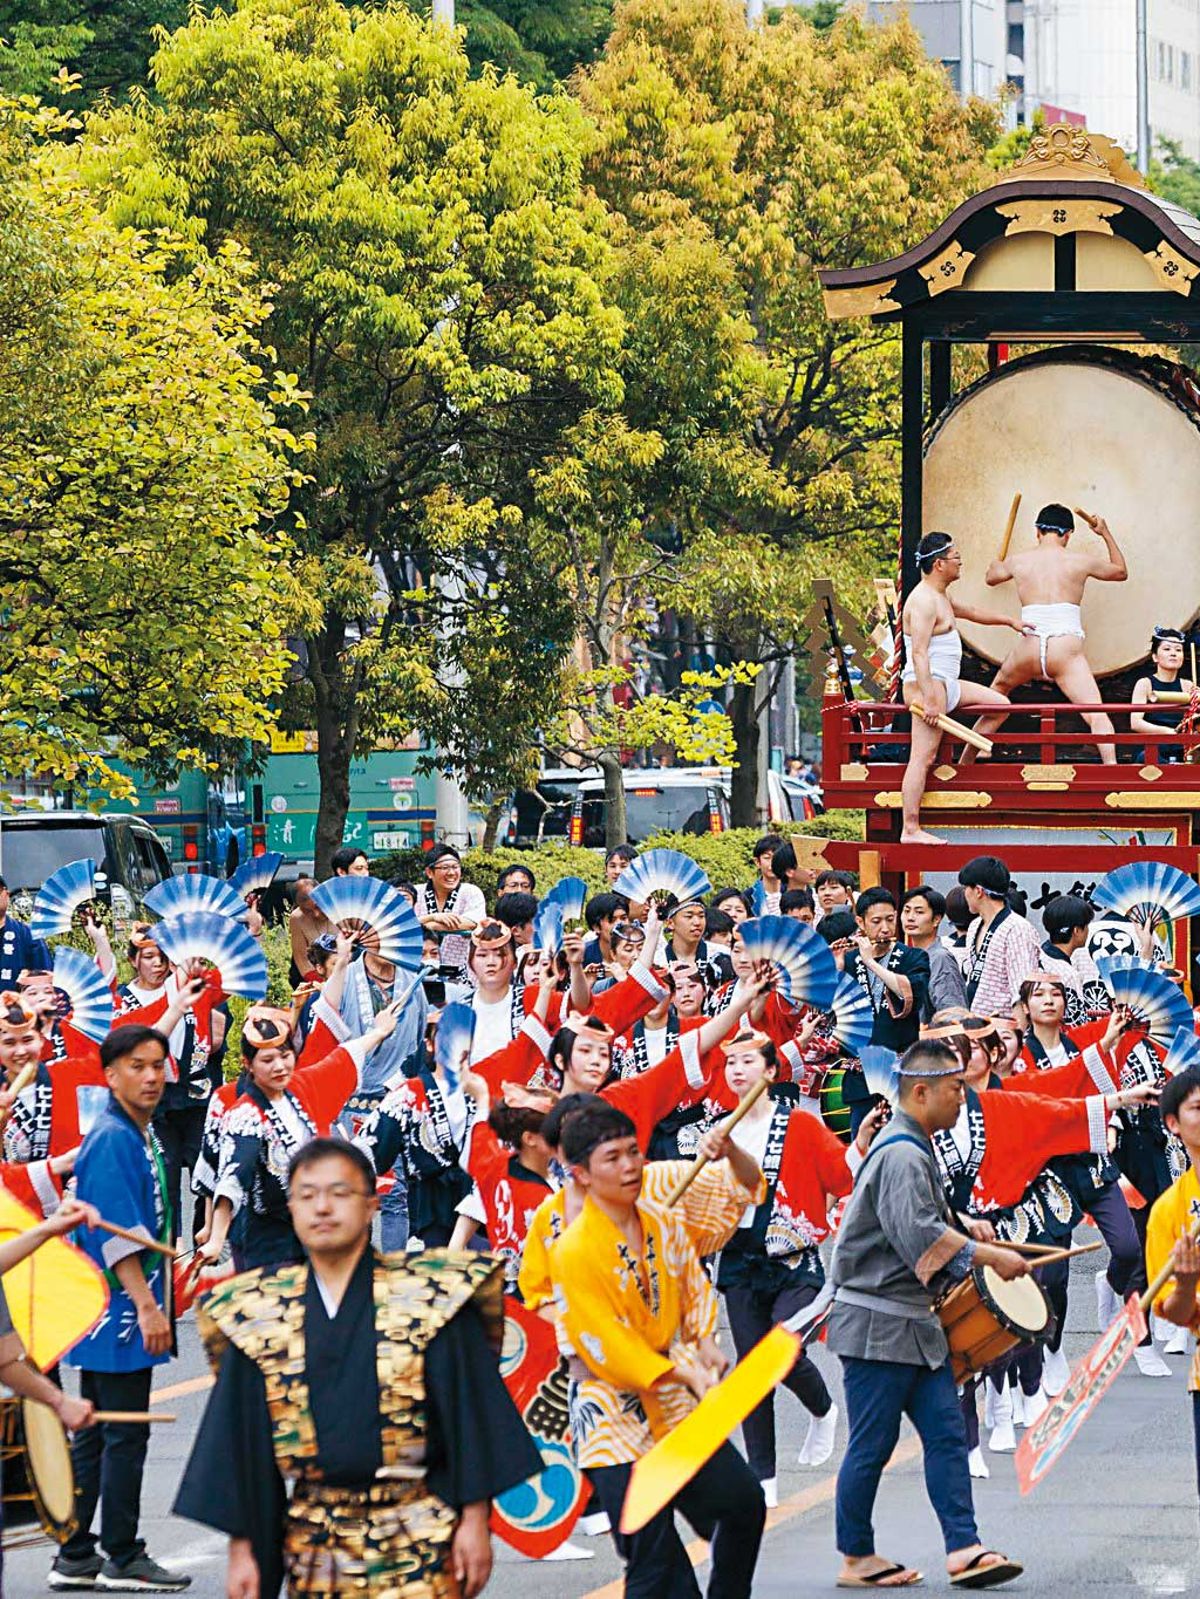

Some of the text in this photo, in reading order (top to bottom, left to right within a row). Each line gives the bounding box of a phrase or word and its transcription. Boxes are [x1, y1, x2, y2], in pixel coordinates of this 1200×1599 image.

[273, 818, 362, 844] 清記
[633, 1037, 650, 1071] 七十七
[33, 1084, 53, 1158] 七十七銀行
[764, 1112, 790, 1185] 七十七銀行
[965, 1109, 986, 1177] 七十七銀行
